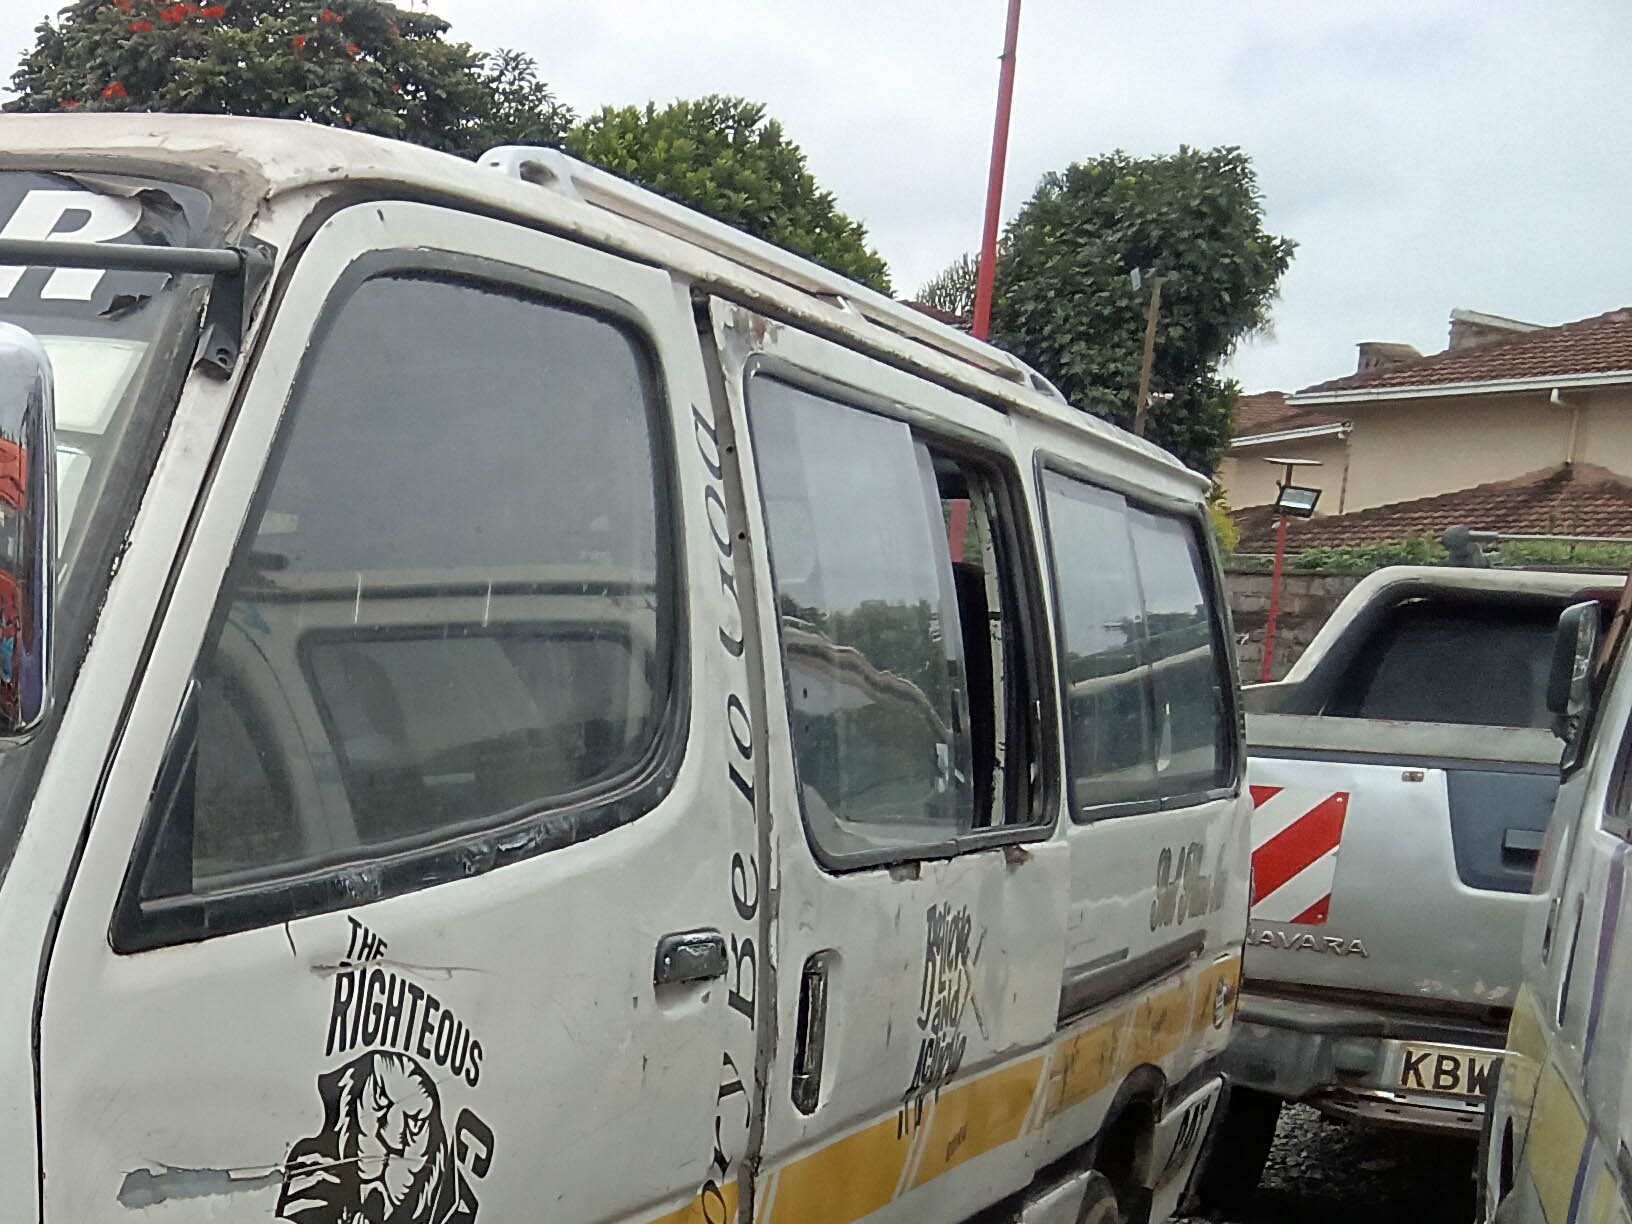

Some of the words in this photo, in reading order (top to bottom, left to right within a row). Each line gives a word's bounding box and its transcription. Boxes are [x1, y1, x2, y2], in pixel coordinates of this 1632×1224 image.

[347, 915, 388, 962] THE
[728, 852, 760, 1031] Be
[325, 961, 483, 1088] RIGHTEOUS
[1400, 1049, 1496, 1096] KBW
